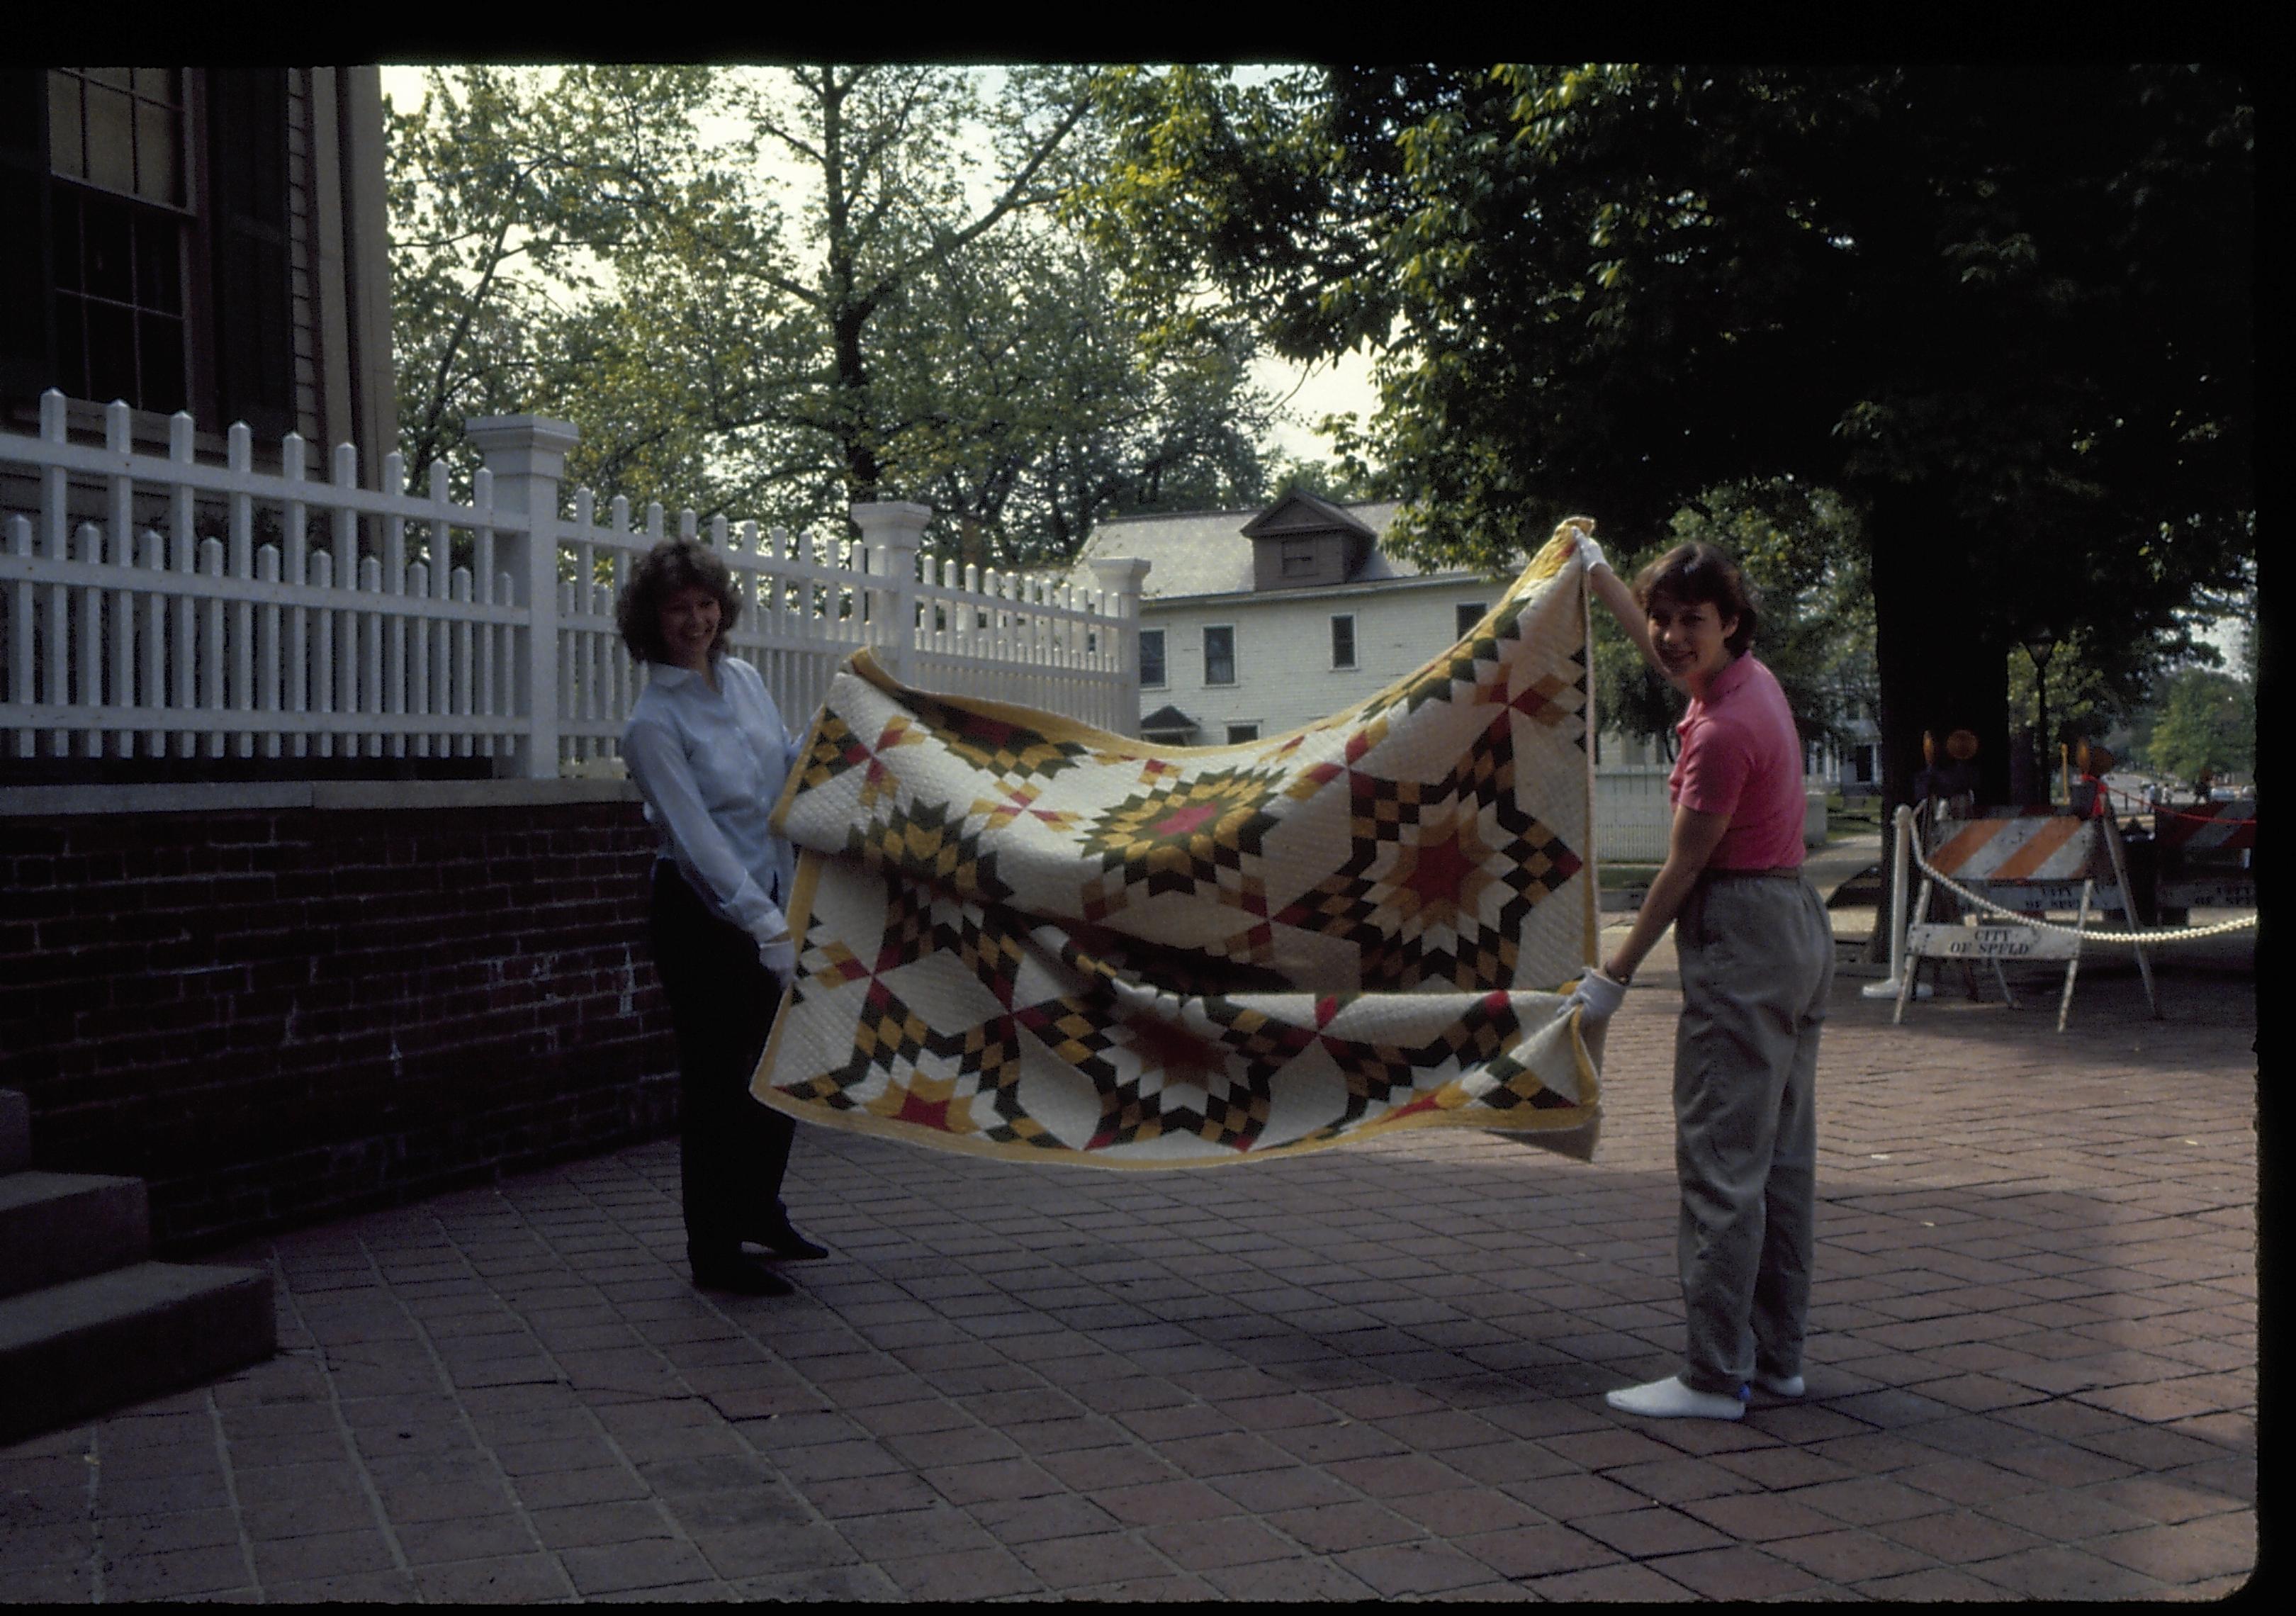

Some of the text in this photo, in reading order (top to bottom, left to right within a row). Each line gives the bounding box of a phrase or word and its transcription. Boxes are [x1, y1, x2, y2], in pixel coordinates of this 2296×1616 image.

[1974, 929, 2012, 941] CITY
[1950, 941, 2030, 954] OF SPFLD
